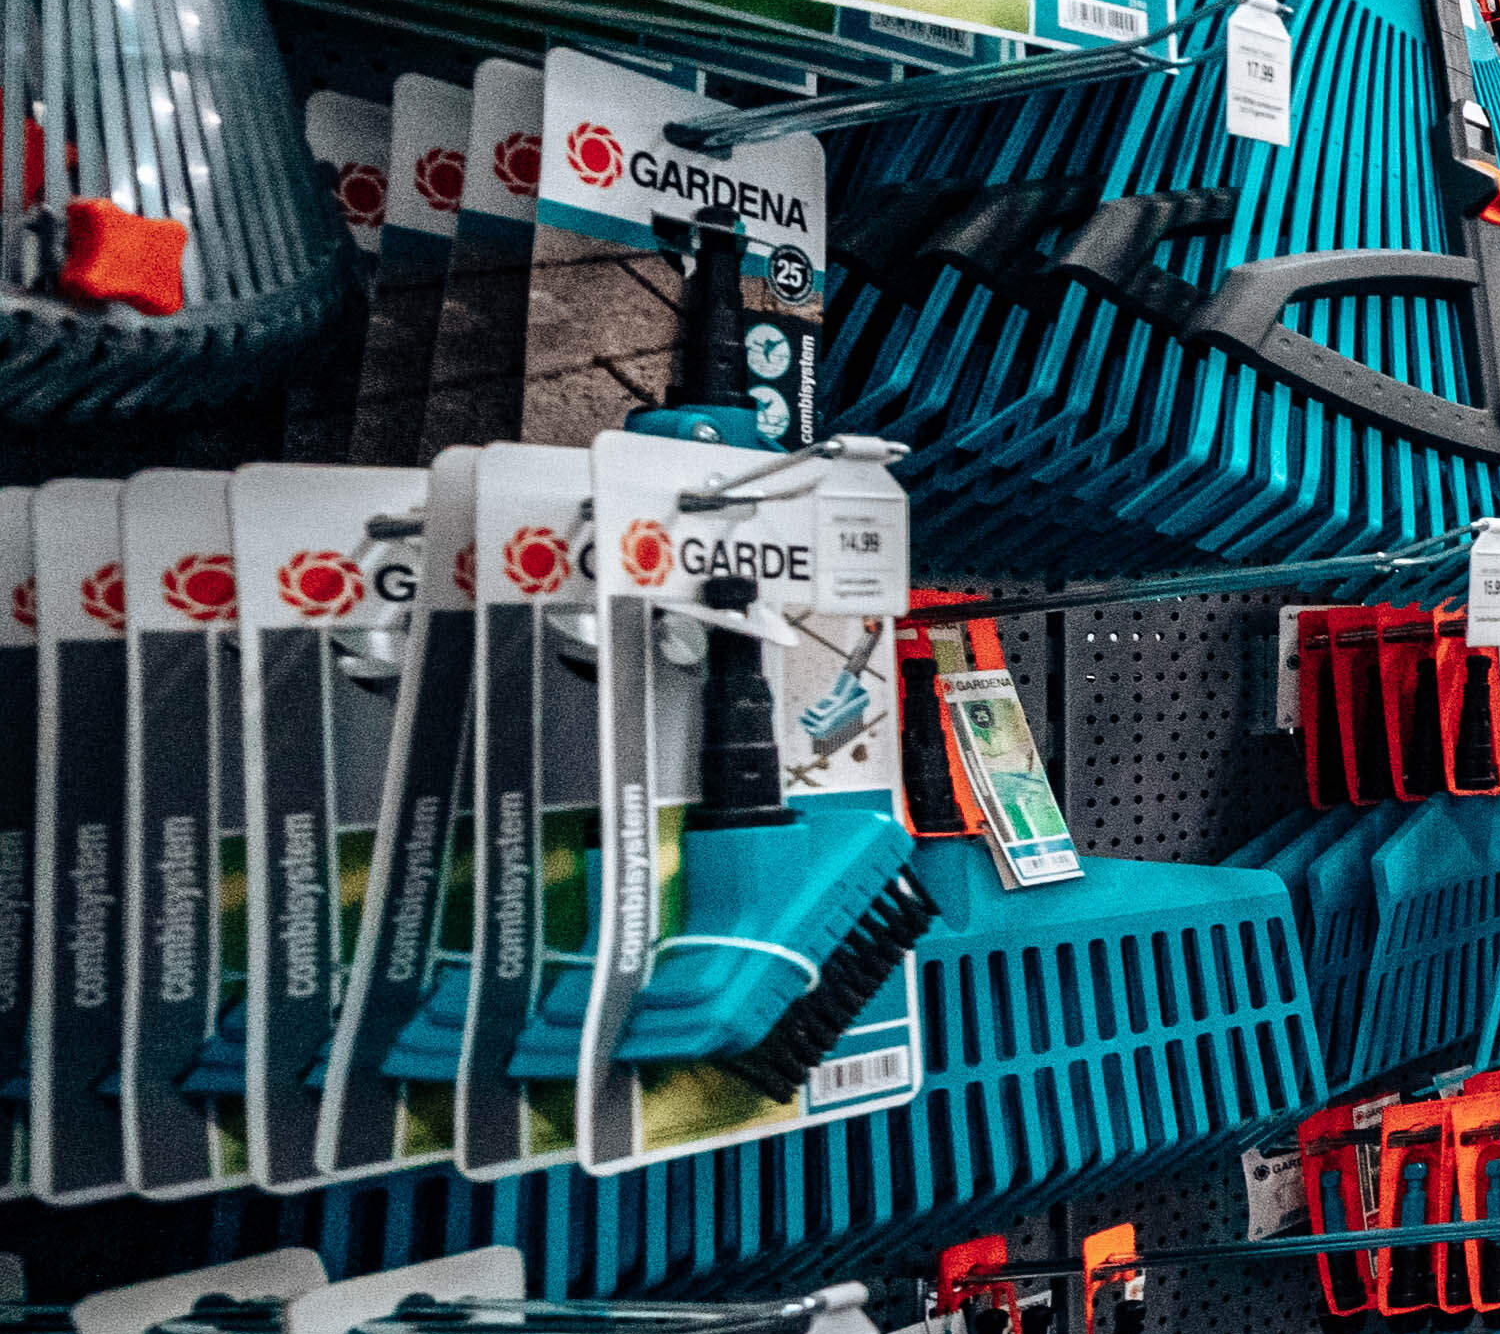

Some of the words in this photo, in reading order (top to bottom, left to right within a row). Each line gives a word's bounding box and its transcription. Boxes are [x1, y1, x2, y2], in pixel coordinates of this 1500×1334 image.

[630, 152, 808, 234] GARDENA
[774, 259, 809, 294] 25
[797, 334, 817, 443] combisystem
[680, 536, 811, 582] GARDE
[955, 676, 1014, 693] GARDENA
[161, 815, 197, 1004] combisystem
[286, 809, 323, 999] combisystem
[388, 794, 441, 981] combisystem
[497, 789, 526, 980] combisystem
[618, 783, 646, 974] combisystem
